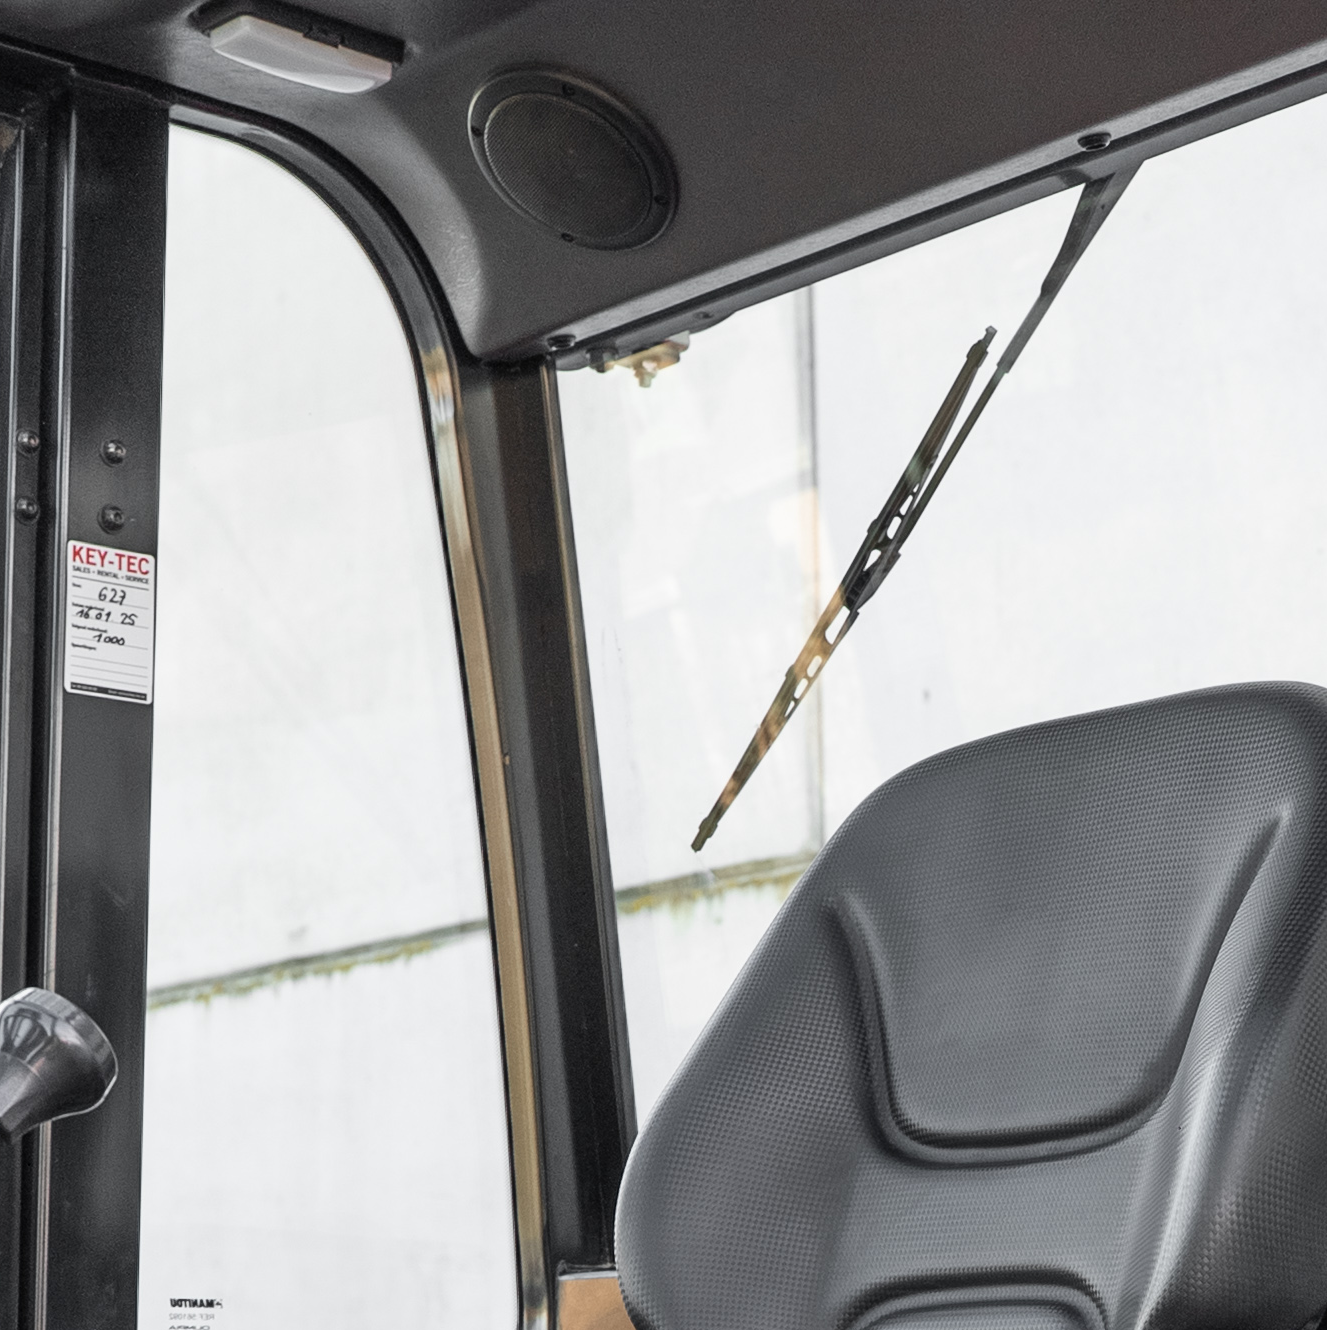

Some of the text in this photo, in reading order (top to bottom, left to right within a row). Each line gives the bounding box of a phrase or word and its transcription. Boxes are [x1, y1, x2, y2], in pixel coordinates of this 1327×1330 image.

[72, 544, 150, 576] KEY-TEC
[72, 565, 150, 585] SALES RENTAL SERVICE
[98, 586, 127, 606] 627
